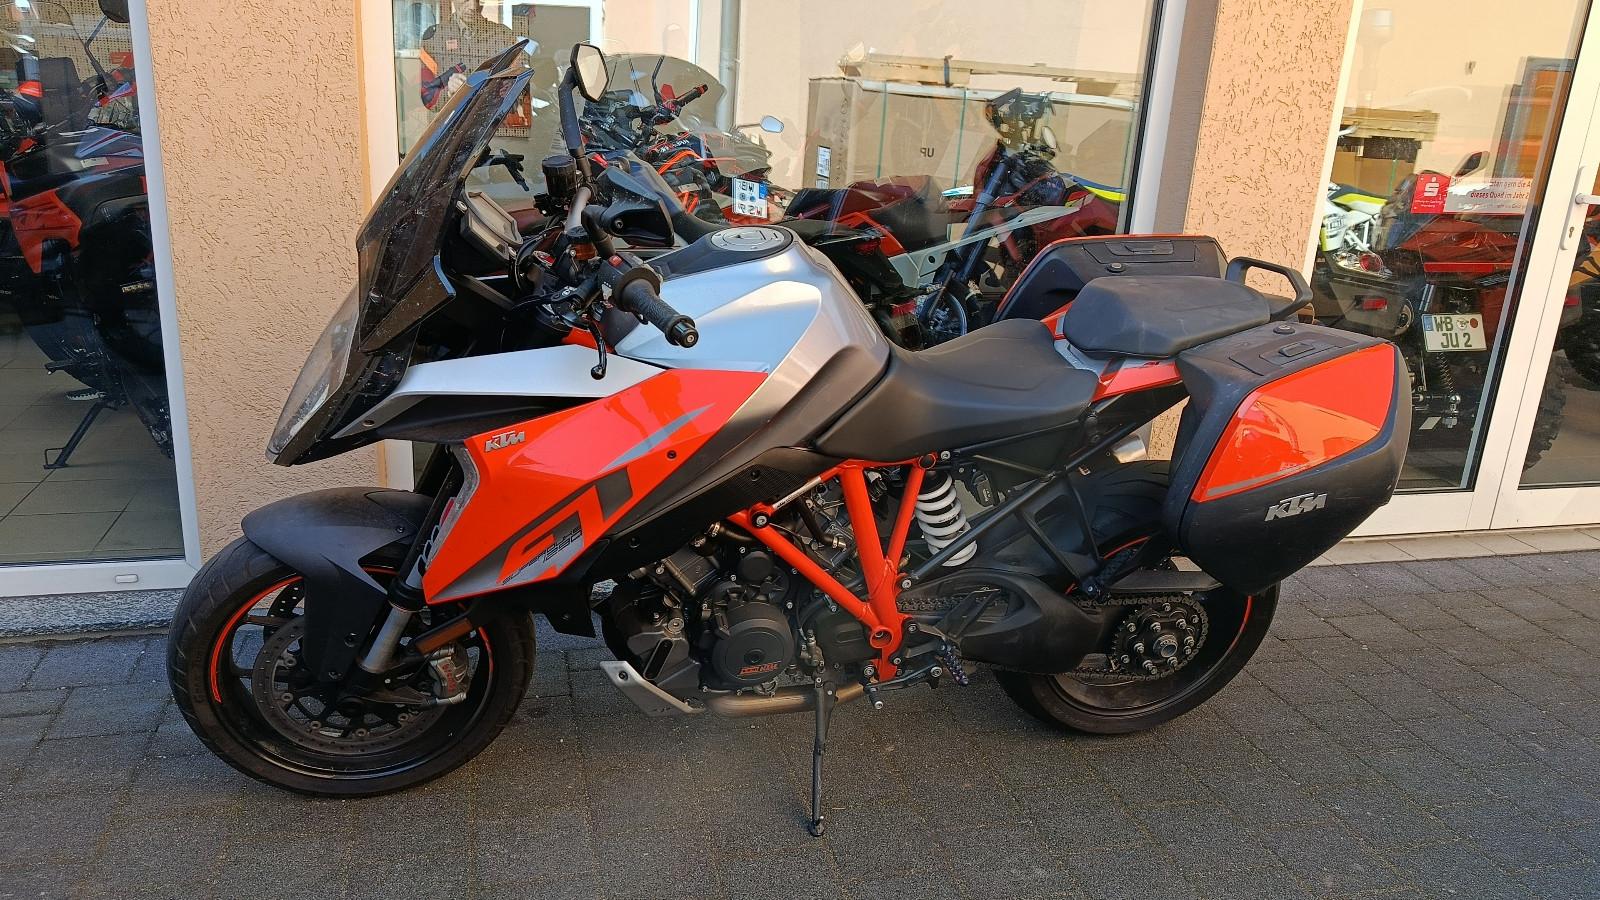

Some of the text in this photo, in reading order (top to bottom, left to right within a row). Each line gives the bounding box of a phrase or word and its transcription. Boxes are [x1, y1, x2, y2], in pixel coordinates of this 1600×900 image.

[1489, 191, 1505, 199] Quad
[1434, 317, 1453, 331] WB
[1441, 333, 1472, 348] JU 2
[485, 431, 525, 452] KTM
[1265, 493, 1328, 521] KTM
